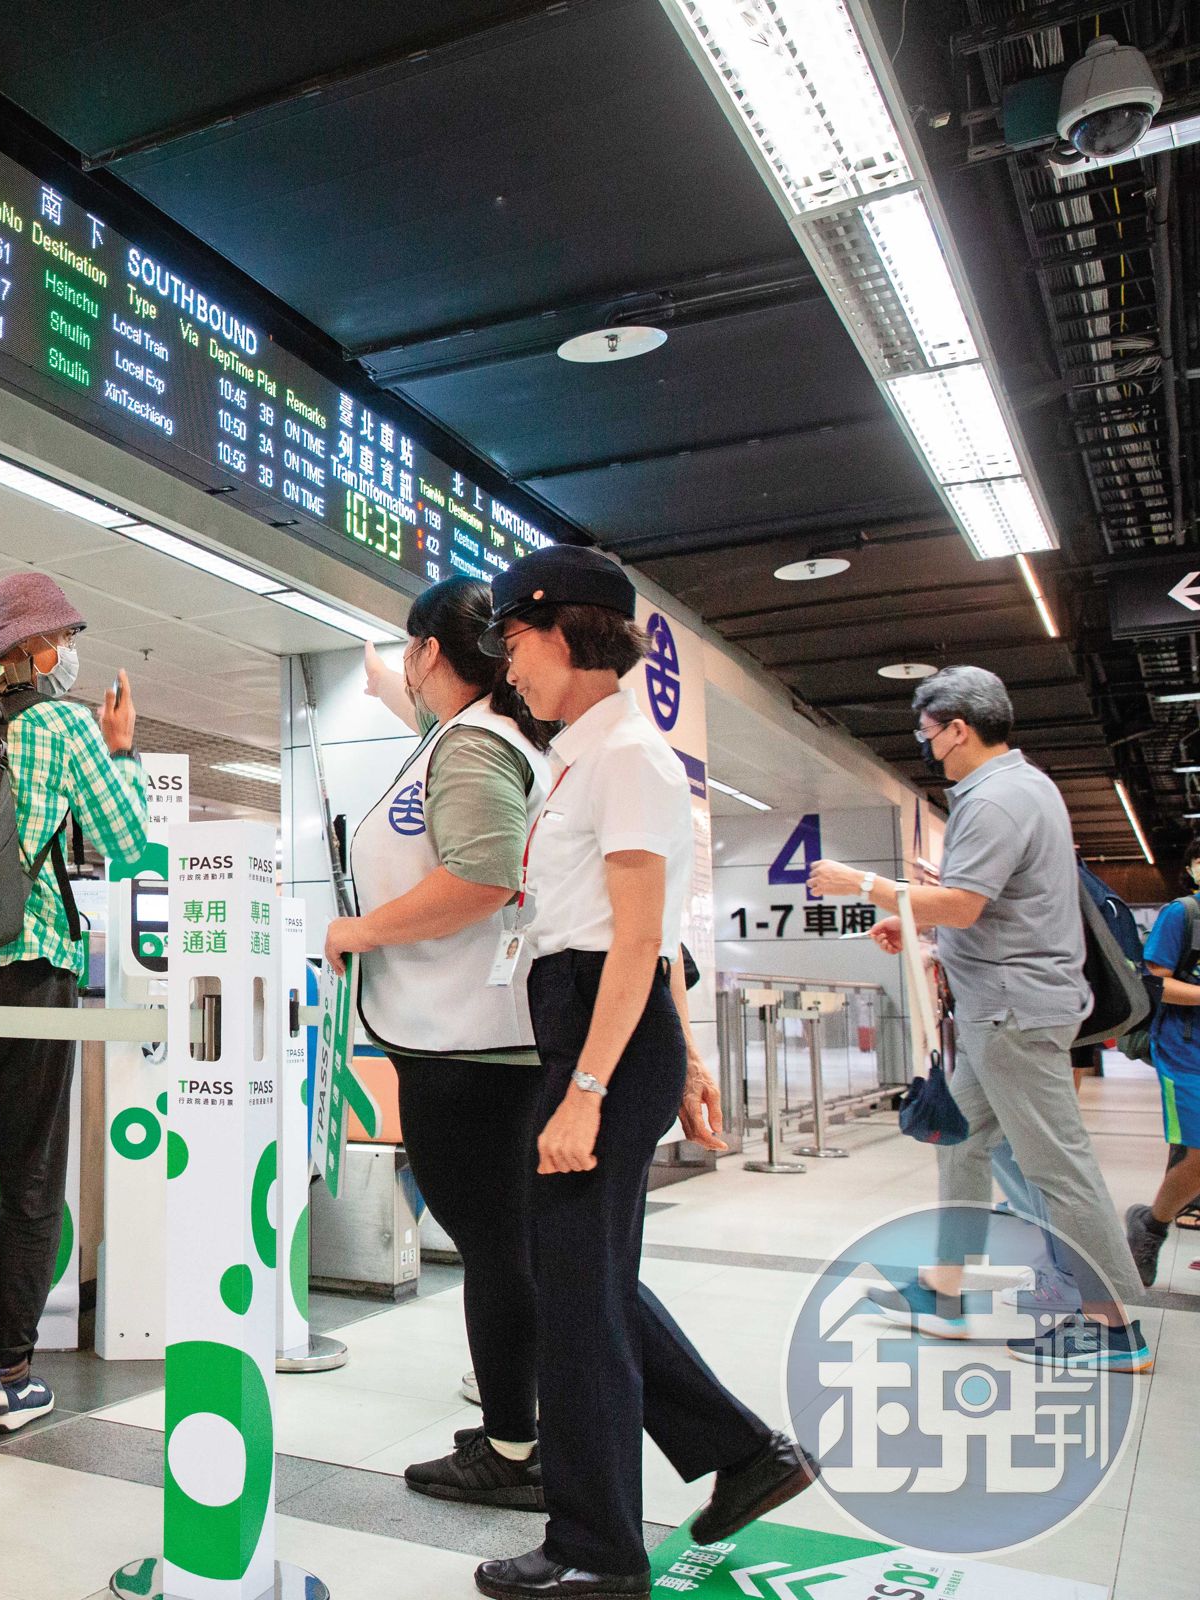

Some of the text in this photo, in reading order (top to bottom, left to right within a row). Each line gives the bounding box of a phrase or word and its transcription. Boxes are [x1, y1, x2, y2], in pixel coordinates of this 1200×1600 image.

[32, 222, 107, 289] Destination
[127, 284, 156, 325] Type
[179, 319, 198, 347] Via
[209, 337, 253, 386] DepTime
[257, 369, 276, 398] Plat
[286, 388, 326, 430] Remarks
[127, 245, 257, 358] SOUTHBOUND
[44, 268, 97, 320] Hsinchu
[112, 312, 141, 346] Local
[143, 331, 168, 363] Train
[219, 376, 247, 411] 10:45
[259, 401, 273, 427] 3B
[284, 417, 300, 443] ON
[301, 427, 325, 459] TIME
[50, 309, 90, 351] Shulin
[115, 349, 143, 382] Local
[145, 367, 164, 397] Exp
[218, 407, 246, 443] 10:50
[259, 432, 273, 458] 3A
[48, 344, 89, 386] Shulin
[104, 379, 172, 435] XinTzechiang
[217, 440, 246, 473] 10:56
[258, 464, 272, 488] 3B
[339, 391, 412, 469] 臺北車站
[331, 454, 416, 525] Train Information
[339, 428, 412, 503] 列車資訊
[346, 487, 400, 562] 10:33
[148, 775, 183, 790] ASS
[179, 855, 233, 870] TPASS
[249, 856, 273, 873] TPASS
[768, 813, 823, 901] 4
[183, 900, 226, 923] 專用
[183, 929, 227, 953] 通道
[250, 900, 270, 925] 專用
[250, 930, 270, 955] 通道
[178, 1080, 233, 1095] TPASS
[249, 1080, 273, 1094] TPASS
